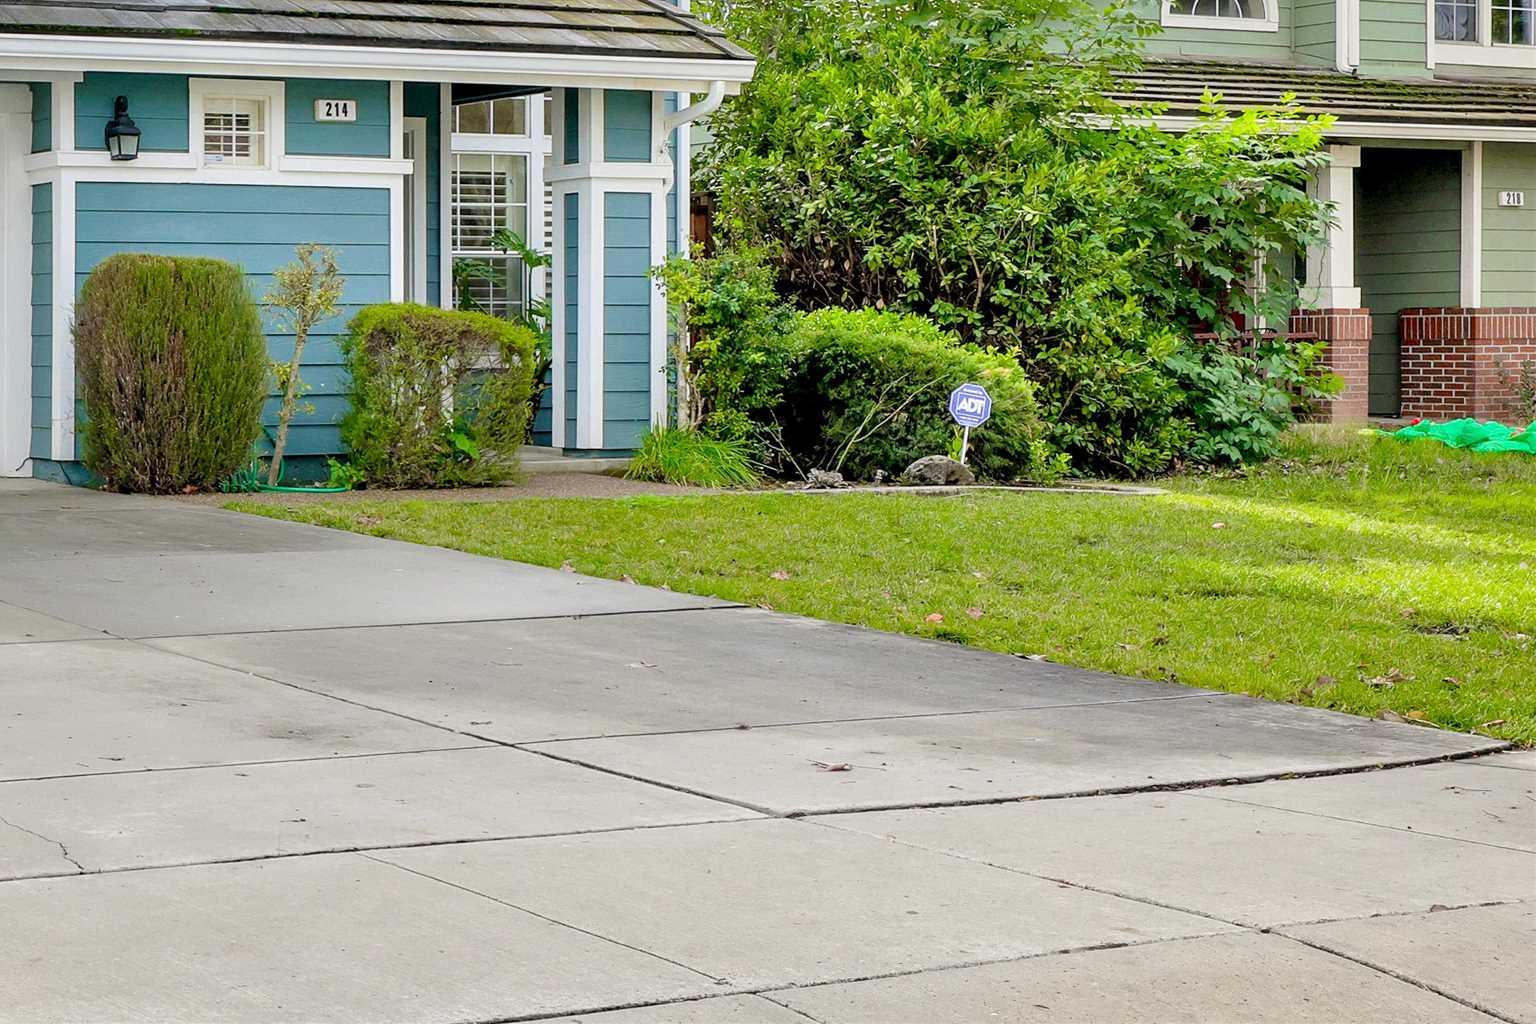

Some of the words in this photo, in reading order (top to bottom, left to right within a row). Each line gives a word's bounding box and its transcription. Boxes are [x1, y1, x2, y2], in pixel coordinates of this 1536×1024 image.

[326, 102, 348, 117] 214
[1506, 193, 1521, 204] 218
[958, 397, 985, 415] ADT
